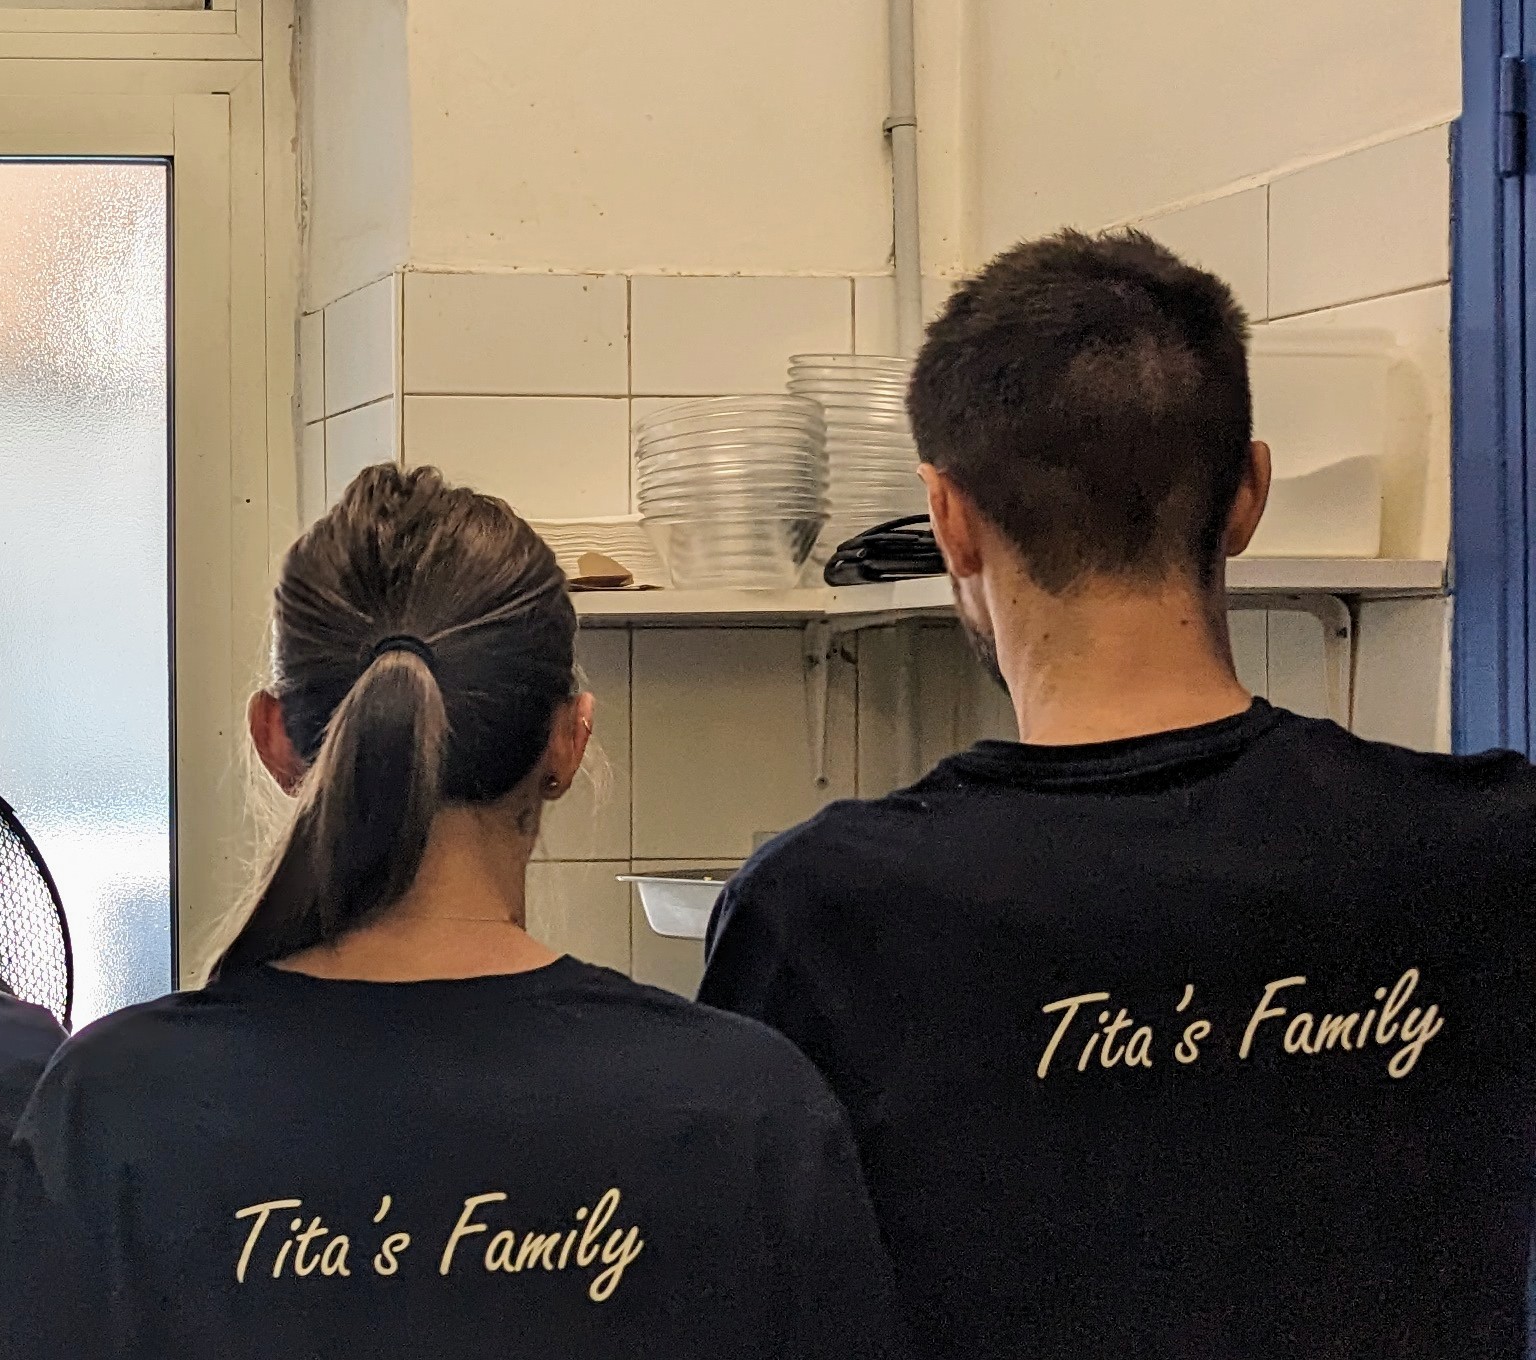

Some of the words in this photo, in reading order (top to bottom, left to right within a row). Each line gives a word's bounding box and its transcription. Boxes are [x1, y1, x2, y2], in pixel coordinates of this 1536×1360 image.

[1037, 984, 1211, 1078] Tita's
[1238, 968, 1443, 1078] Family
[235, 1195, 410, 1284] Tita's
[440, 1188, 643, 1302] Family
